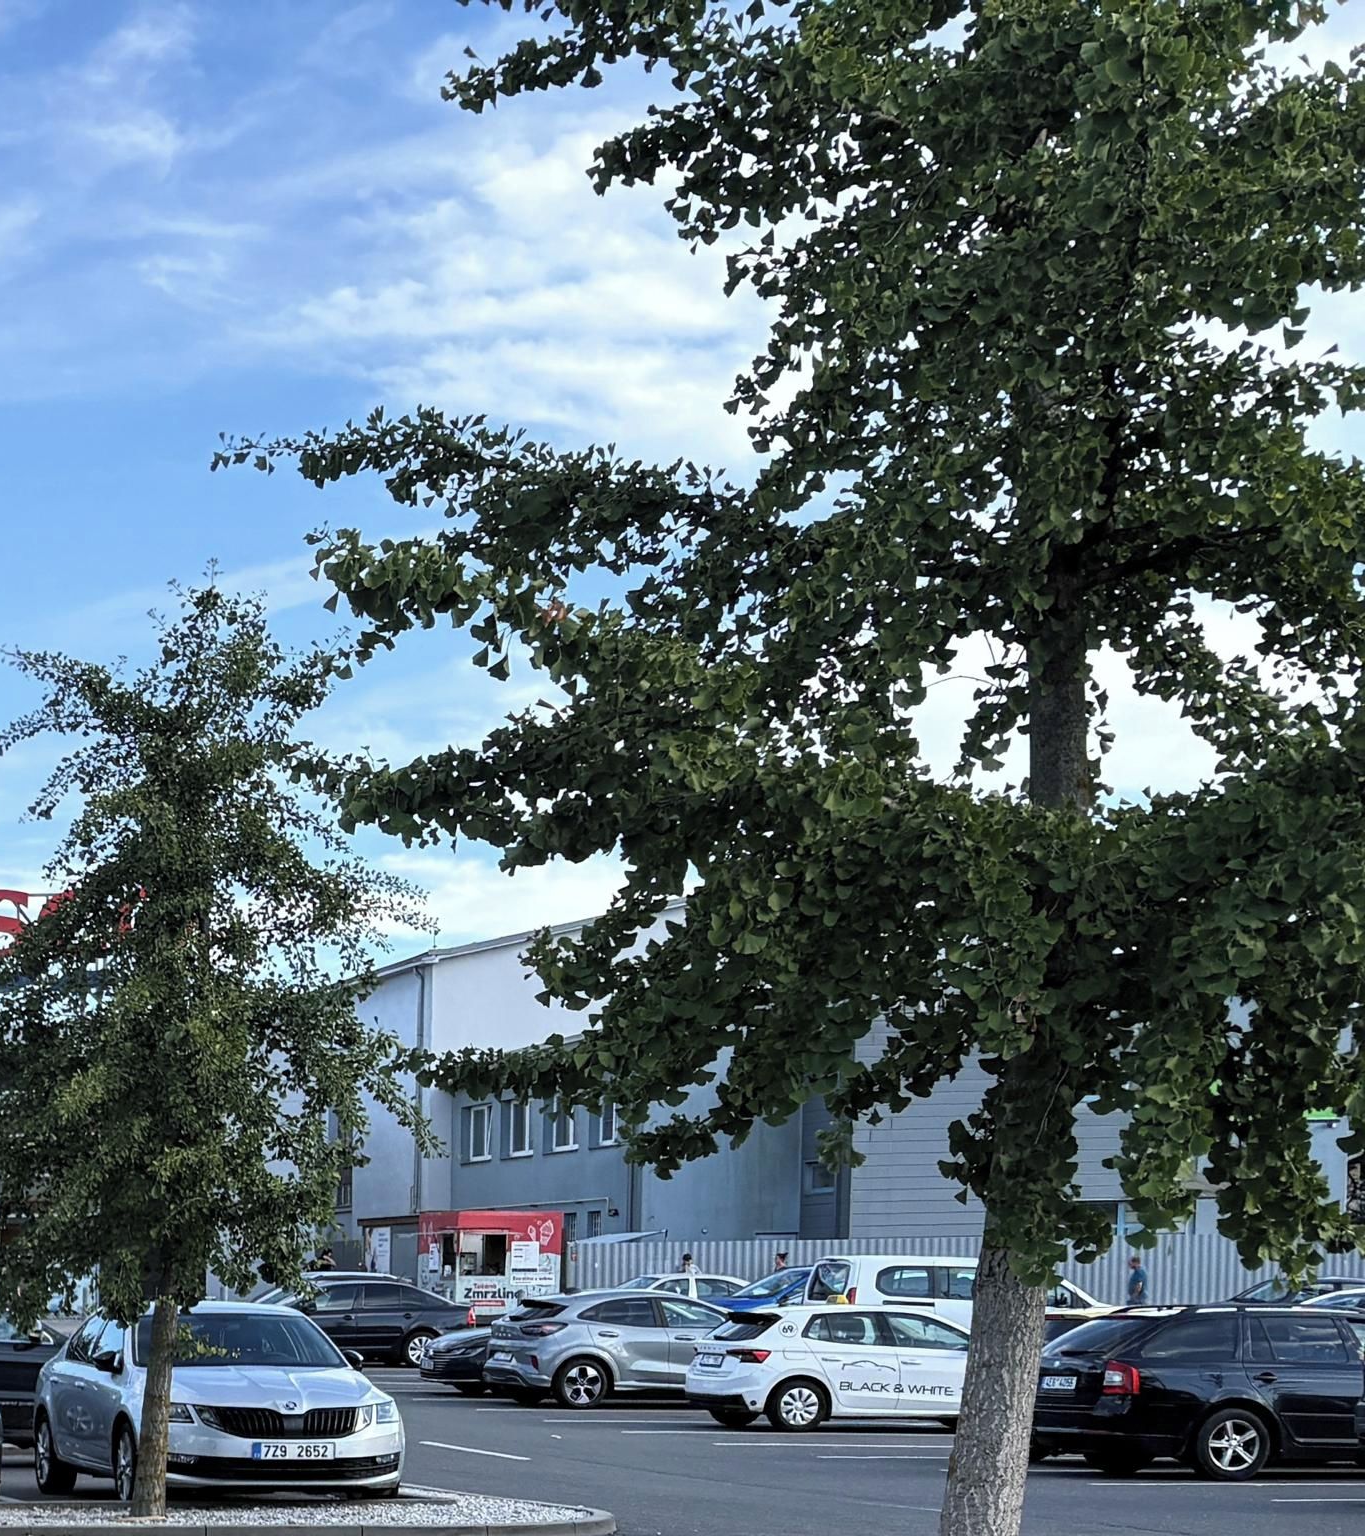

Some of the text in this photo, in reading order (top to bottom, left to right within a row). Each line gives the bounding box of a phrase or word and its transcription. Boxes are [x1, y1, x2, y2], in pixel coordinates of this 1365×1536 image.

[781, 1325, 794, 1334] 69
[839, 1381, 955, 1397] BLACK & WHITE
[263, 1444, 328, 1458] 7Z9 2652
